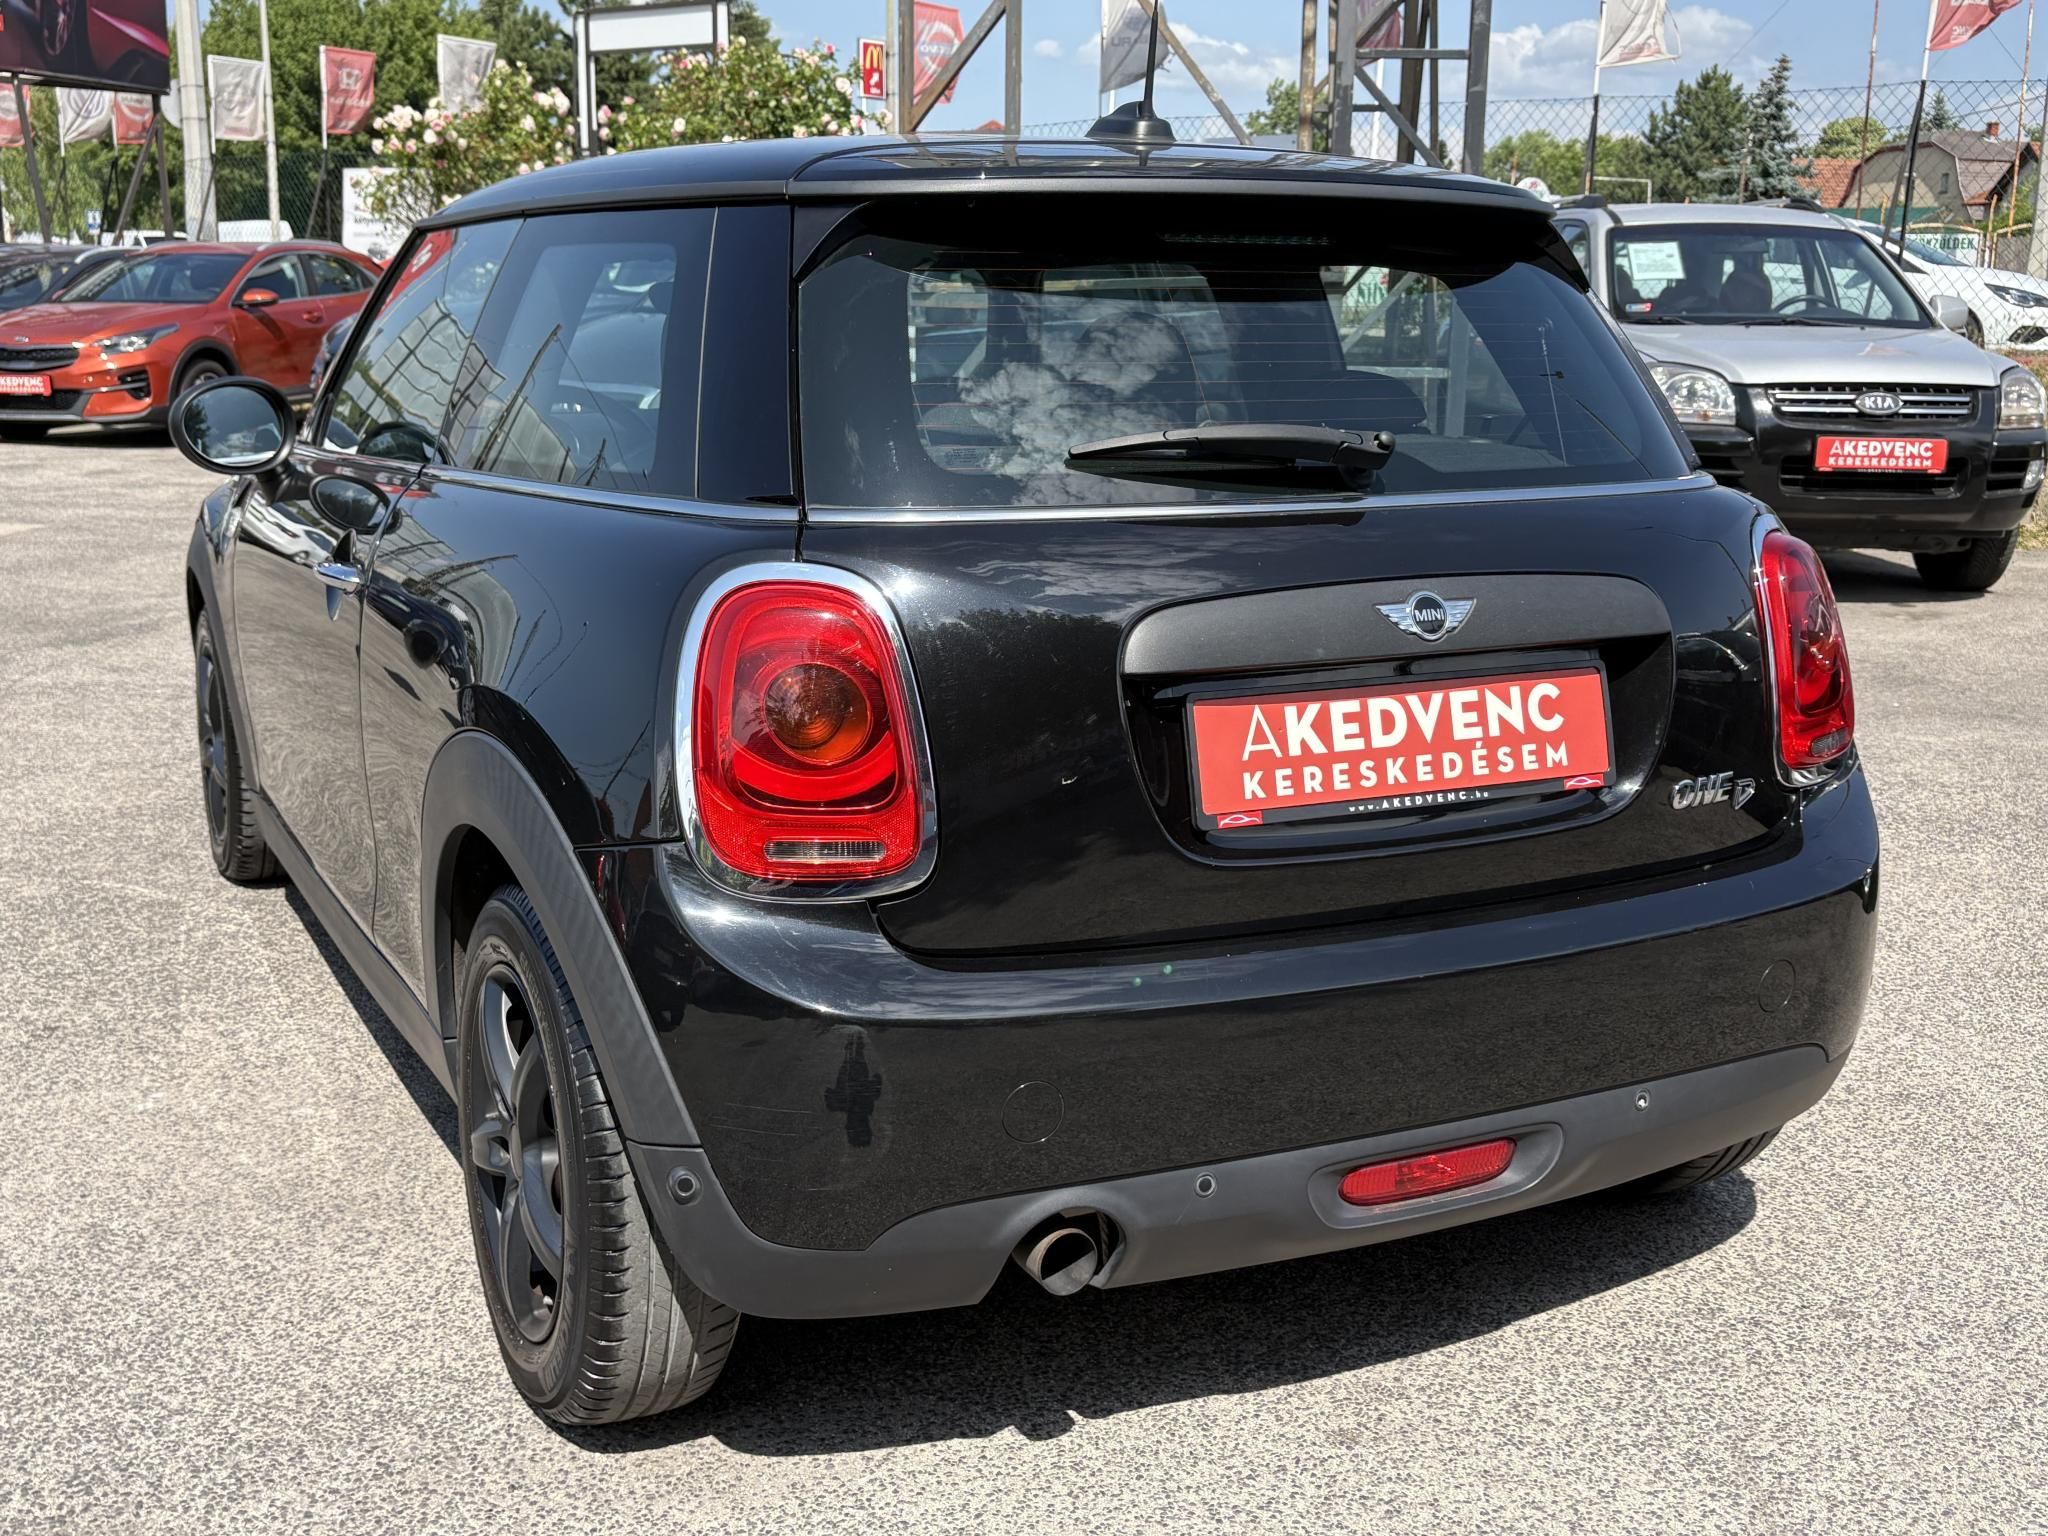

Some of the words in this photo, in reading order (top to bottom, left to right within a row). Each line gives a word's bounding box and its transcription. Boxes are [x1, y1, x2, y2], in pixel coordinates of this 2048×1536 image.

[0, 376, 43, 386] KEDVENC
[1864, 396, 1895, 409] KIA
[1414, 608, 1445, 622] MINI
[1242, 682, 1565, 761] AKEDVENC
[1243, 740, 1569, 800] KERESKEDÉSEM
[1348, 790, 1489, 812] www.AKEDVENC.hu
[1672, 771, 1734, 810] ONE
